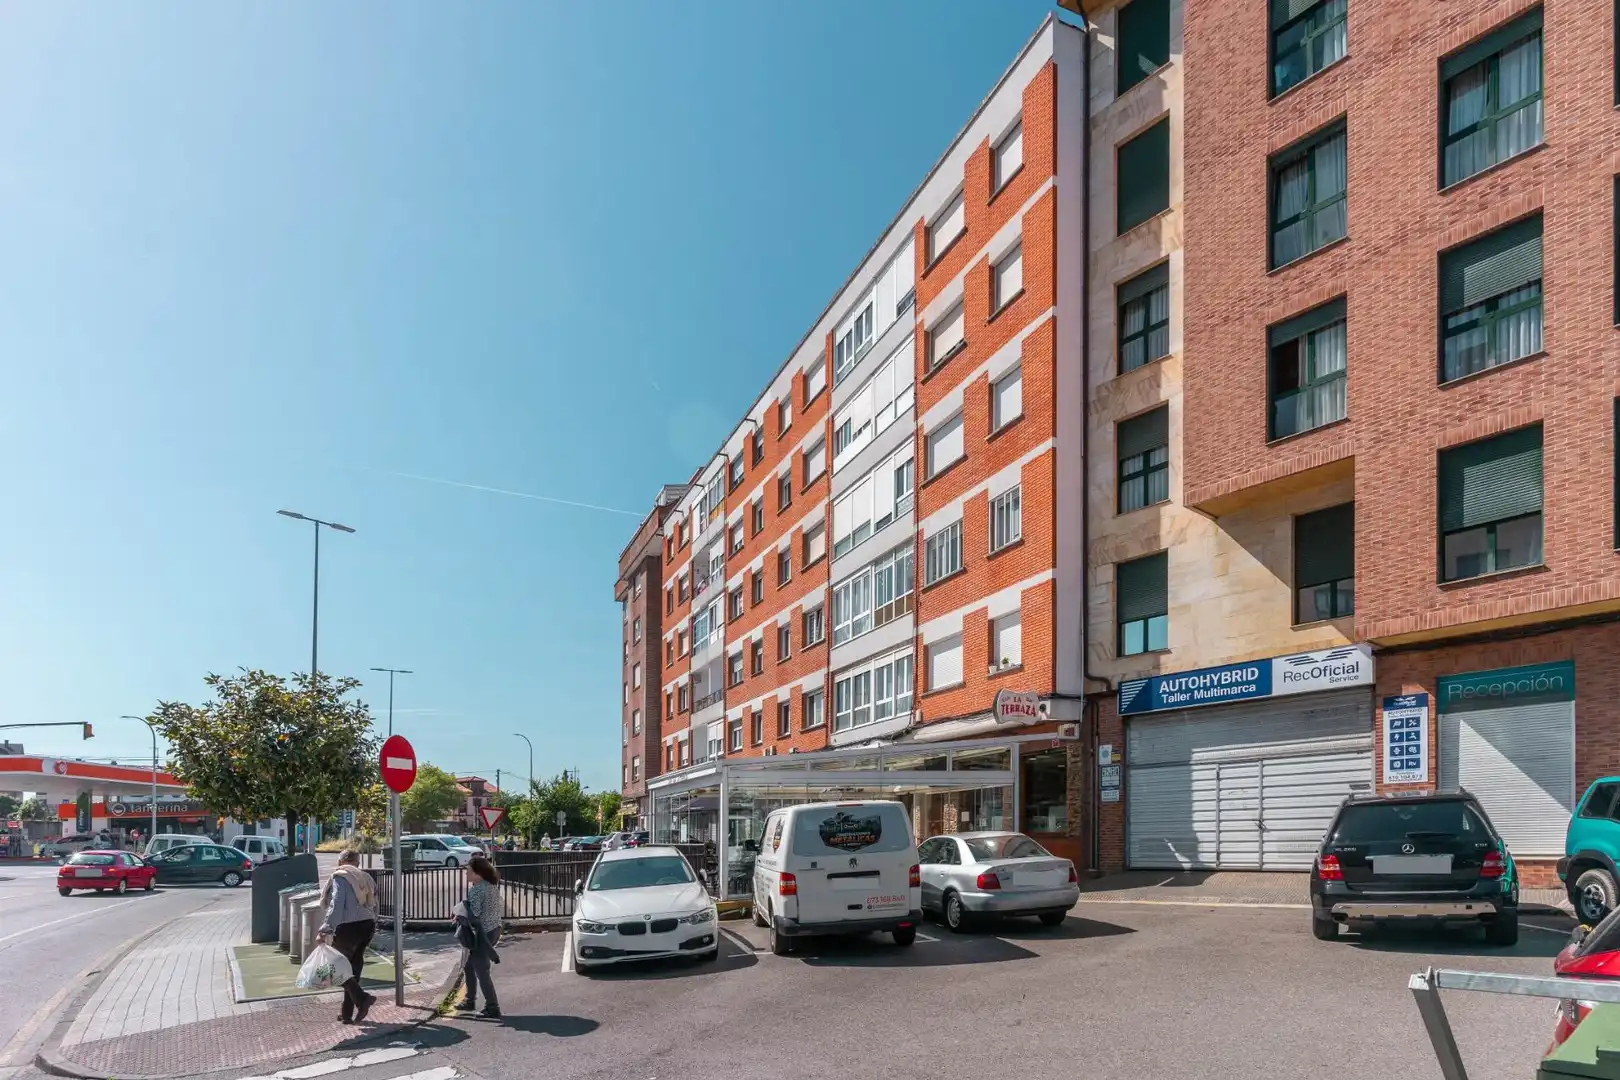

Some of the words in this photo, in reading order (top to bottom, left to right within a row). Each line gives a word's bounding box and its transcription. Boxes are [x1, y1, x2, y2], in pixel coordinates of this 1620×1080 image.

[1159, 667, 1259, 694] AUTOHYBRID
[1283, 661, 1360, 684] RecOficial
[1329, 674, 1360, 684] Service
[1161, 691, 1192, 704] Taller
[1193, 683, 1256, 701] Multimarca
[1448, 673, 1563, 700] Recepción
[1001, 704, 1037, 718] TERRAZA
[130, 803, 189, 813] tanerina
